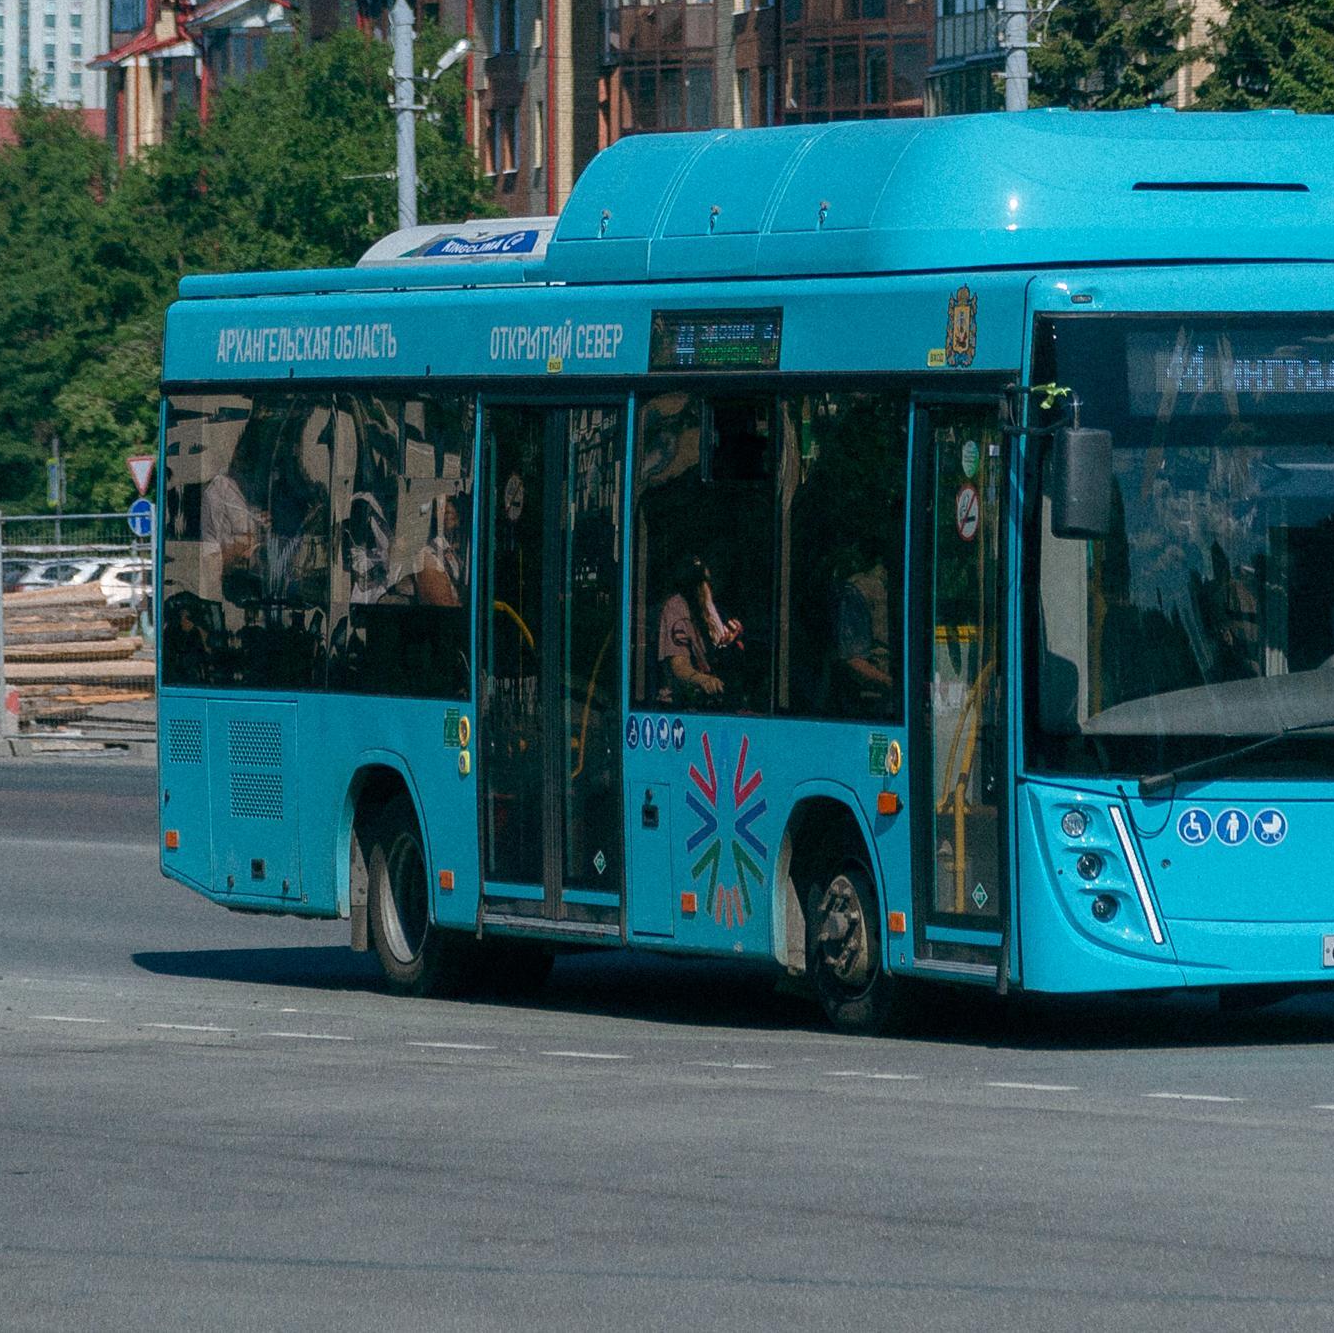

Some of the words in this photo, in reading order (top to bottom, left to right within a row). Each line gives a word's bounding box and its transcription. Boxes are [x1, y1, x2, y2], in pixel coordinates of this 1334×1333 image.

[441, 239, 504, 254] KINGCLIMA
[217, 326, 332, 363] АРХАНГЕЛЬСКАЯ
[334, 323, 398, 360] ОБЛАСТЬ
[490, 318, 572, 360] ОТКРЫТЫЙ
[575, 324, 624, 359] СЕВЕР
